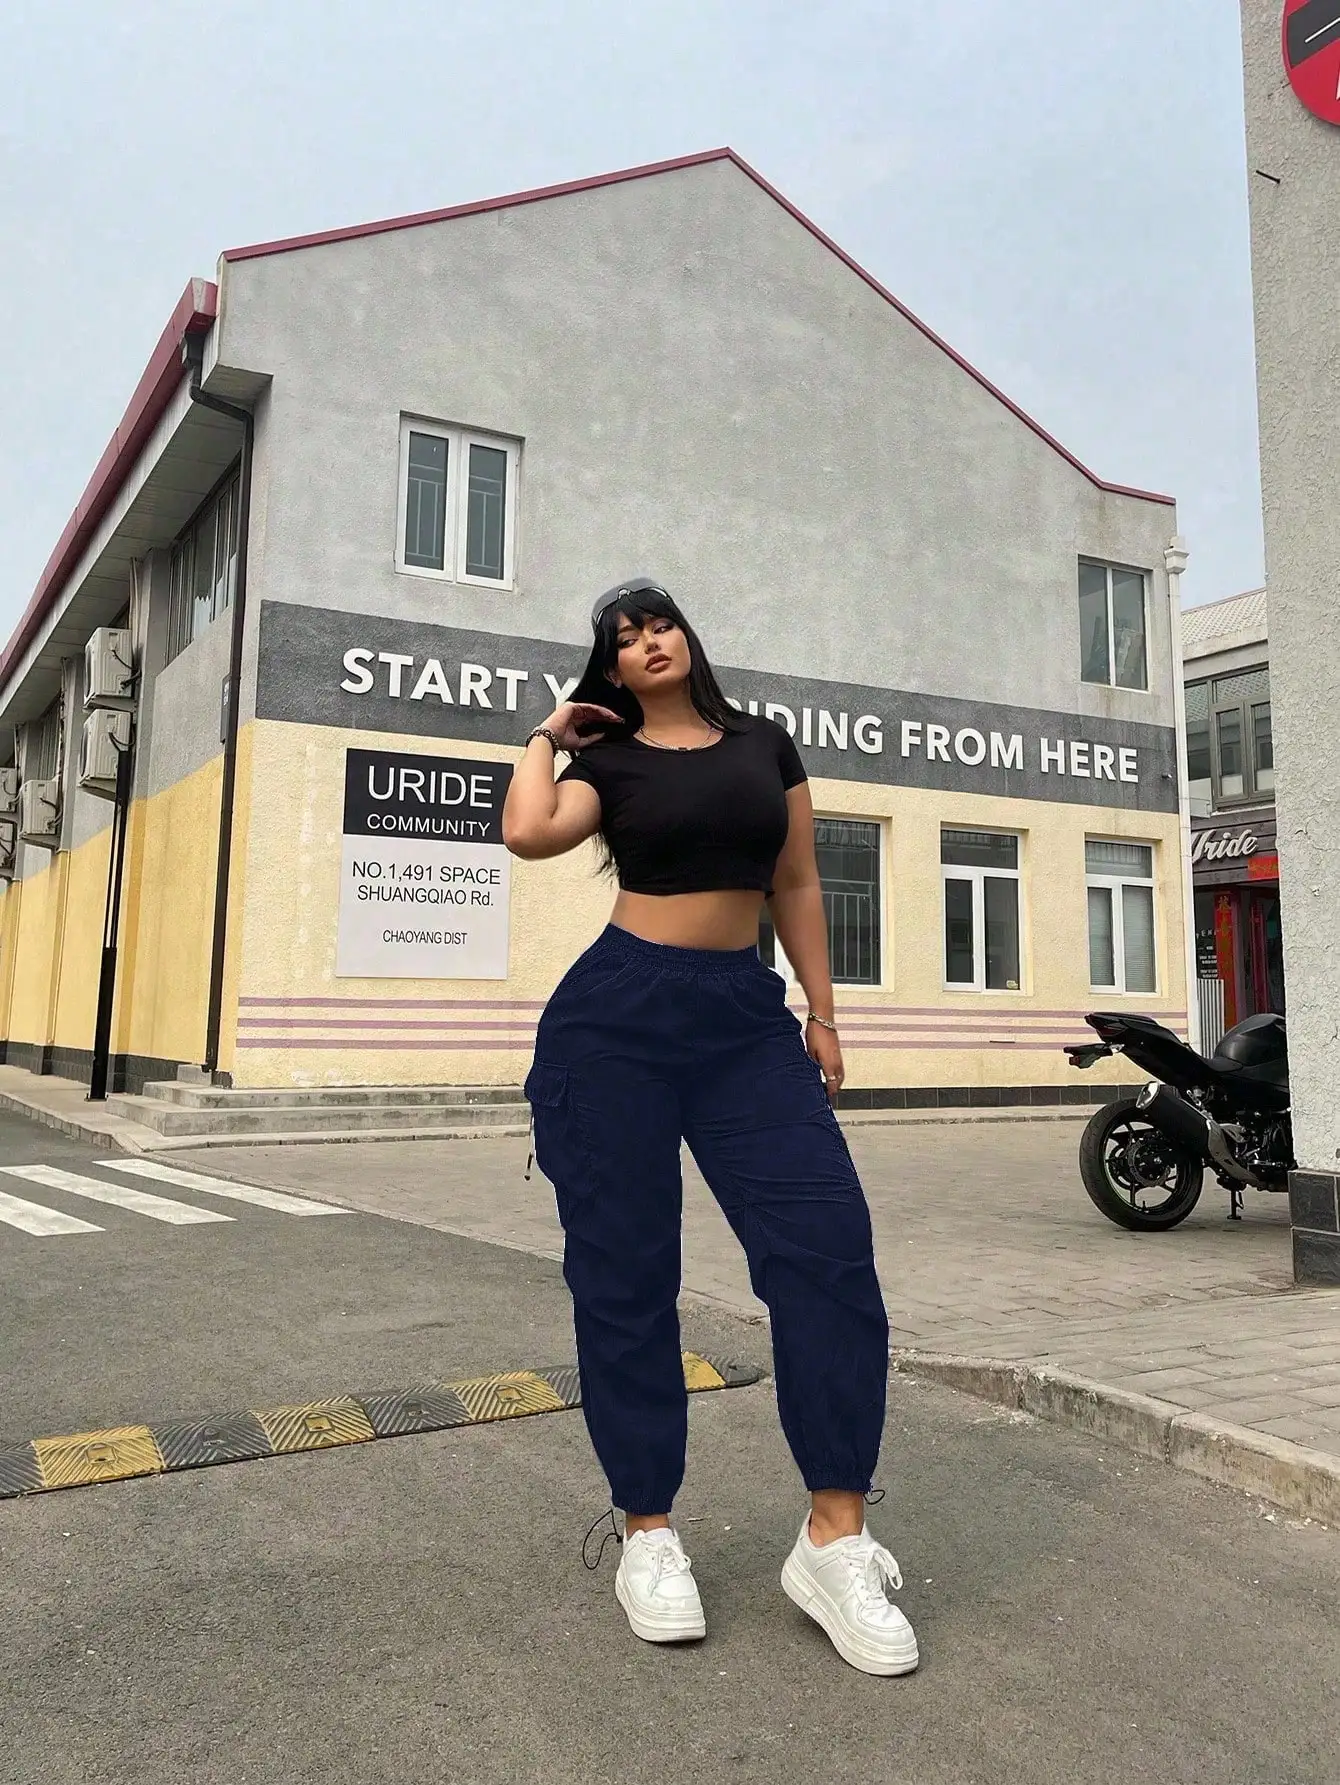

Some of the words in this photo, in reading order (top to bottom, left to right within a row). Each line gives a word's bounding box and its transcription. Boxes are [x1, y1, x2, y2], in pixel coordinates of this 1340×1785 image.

[340, 647, 529, 712] START
[724, 697, 883, 755] DING
[901, 720, 1024, 770] FROM
[1041, 738, 1139, 783] HERE
[368, 765, 493, 809] URIDE
[366, 813, 491, 837] COMMUNITY
[352, 861, 434, 882] NO.1,491
[439, 866, 501, 885] SPACE
[357, 885, 467, 904] SHUANGQIAO
[470, 890, 494, 906] Rd.
[382, 929, 442, 945] CHAOYANG
[444, 931, 467, 945] DIST
